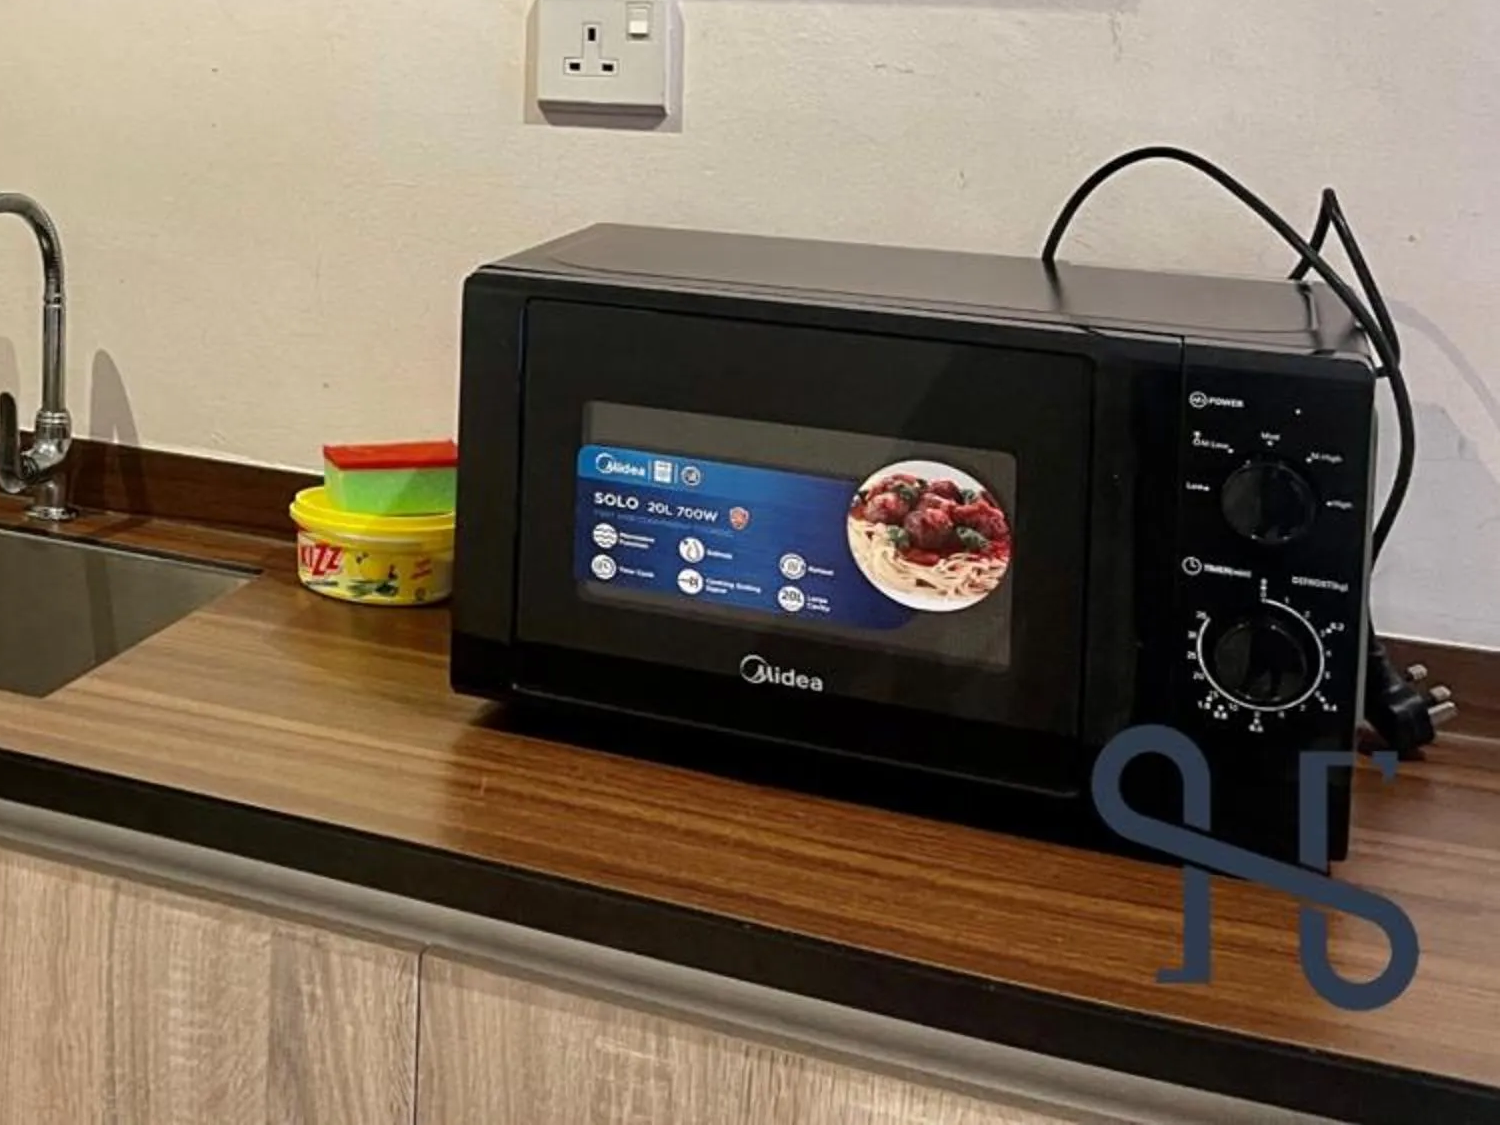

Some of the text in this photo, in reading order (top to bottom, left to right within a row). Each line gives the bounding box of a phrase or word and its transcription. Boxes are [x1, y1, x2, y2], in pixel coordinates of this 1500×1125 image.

[595, 452, 646, 477] Midea
[593, 491, 640, 511] SOLO
[647, 502, 673, 516] 20L
[677, 506, 719, 523] 700W
[740, 654, 823, 692] Midea
